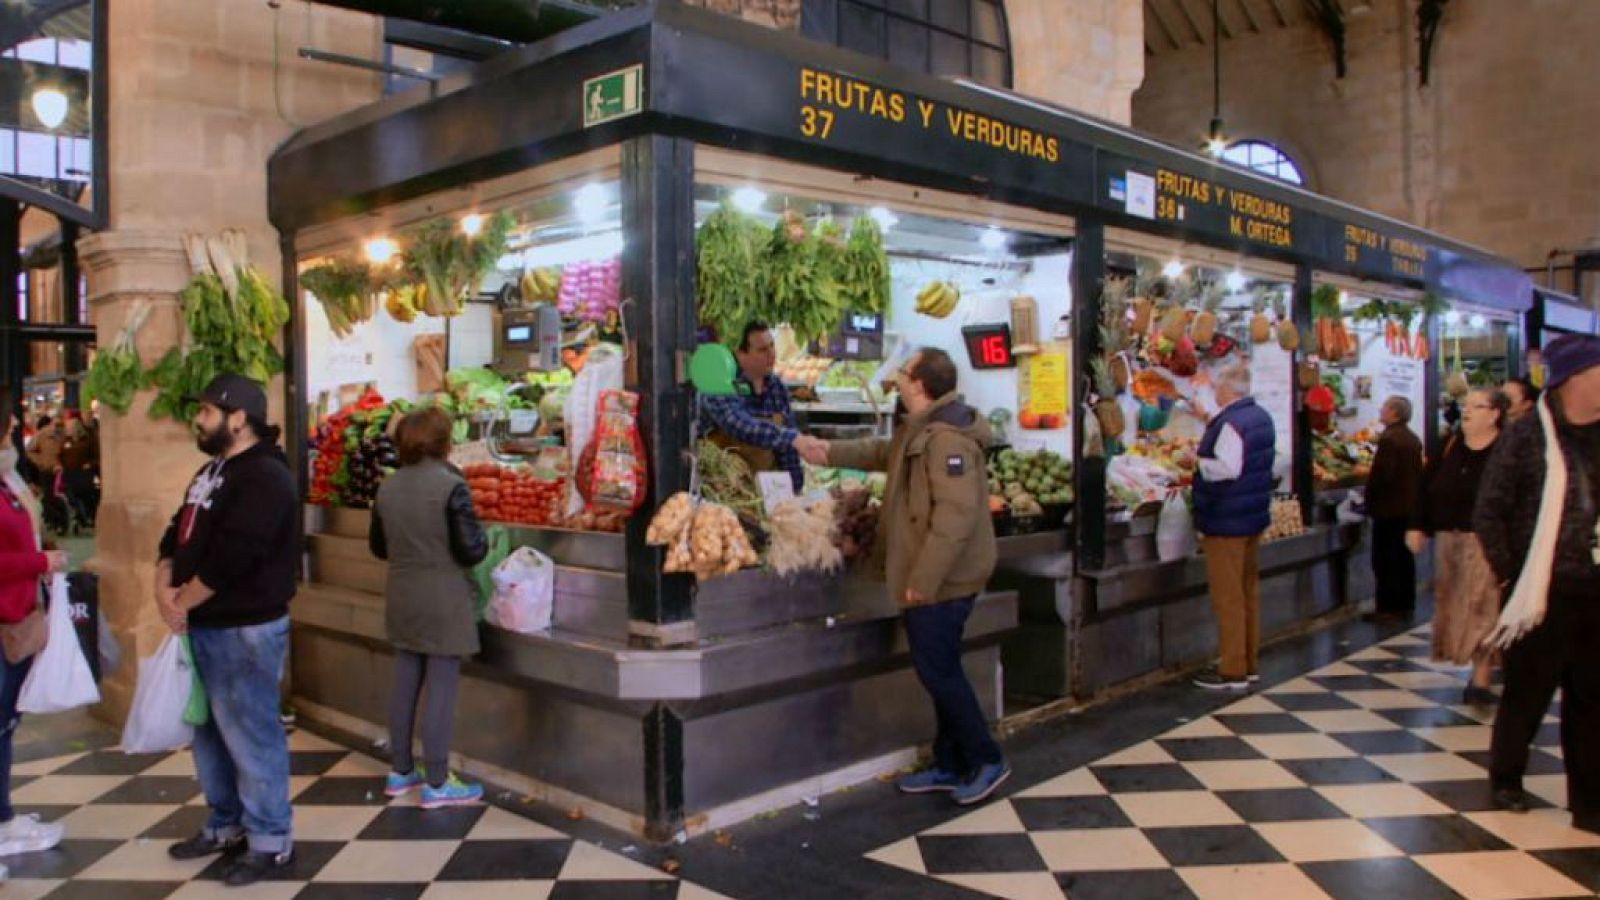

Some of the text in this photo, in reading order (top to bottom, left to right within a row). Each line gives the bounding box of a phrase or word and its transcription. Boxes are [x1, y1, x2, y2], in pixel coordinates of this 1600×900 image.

[801, 68, 1059, 162] FRUTAS Y VERDURAS
[801, 106, 835, 140] 37
[1157, 169, 1291, 224] FRUTAS Y VERDURAS
[1247, 220, 1292, 247] ORTEGA
[982, 335, 1009, 366] 16
